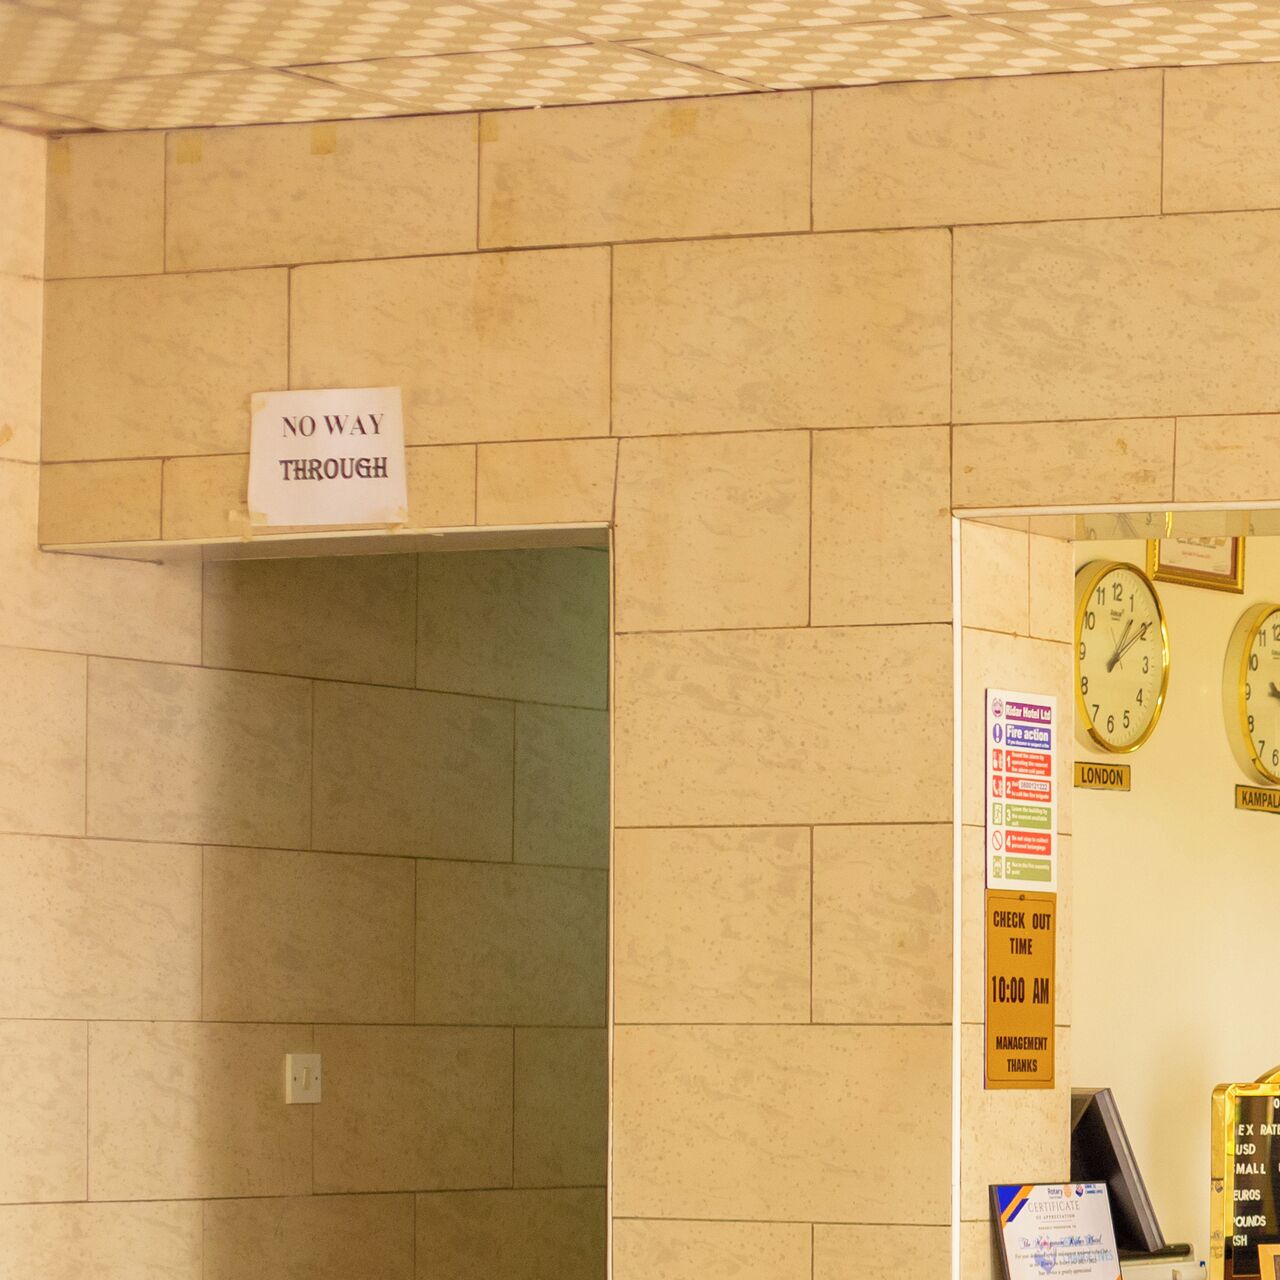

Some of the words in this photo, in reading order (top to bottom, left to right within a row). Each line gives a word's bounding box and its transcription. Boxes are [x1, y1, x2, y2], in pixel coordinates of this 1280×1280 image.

[281, 415, 317, 438] NO
[323, 413, 385, 435] WAY
[279, 456, 389, 481] THROUGH
[1096, 586, 1105, 605] 11
[1112, 582, 1123, 602] 12
[1129, 593, 1134, 612] 1
[1084, 611, 1096, 630] 10
[1258, 629, 1267, 647] 11
[1142, 655, 1149, 674] 3
[1081, 676, 1089, 695] 8
[1135, 688, 1143, 706] 4
[1023, 706, 1040, 719] Hotel
[1040, 708, 1051, 720] Ltd
[1092, 704, 1100, 723] 7
[1122, 710, 1130, 728] 5
[1107, 715, 1114, 733] 6
[1007, 725, 1022, 739] Fire
[1024, 728, 1049, 742] action
[1258, 740, 1265, 758] 7
[1272, 749, 1279, 766] 6
[1006, 755, 1011, 768] 1
[1081, 766, 1123, 786] LONDON
[1006, 782, 1011, 794] 2
[1006, 808, 1011, 821] 3
[1006, 835, 1011, 848] 4
[1006, 861, 1011, 874] 5
[993, 910, 1025, 929] CHECK
[1032, 913, 1051, 930] OUT
[1010, 937, 1033, 955] TIME
[991, 975, 1025, 1003] 10:00
[1032, 977, 1049, 1004] AM
[996, 1035, 1048, 1051] MANAGEMENT
[1007, 1058, 1038, 1073] THANKS
[1238, 1124, 1254, 1136] EX
[1235, 1143, 1256, 1155] USD
[1048, 1188, 1062, 1196] Rotary
[1028, 1200, 1080, 1213] CERTIFICATE
